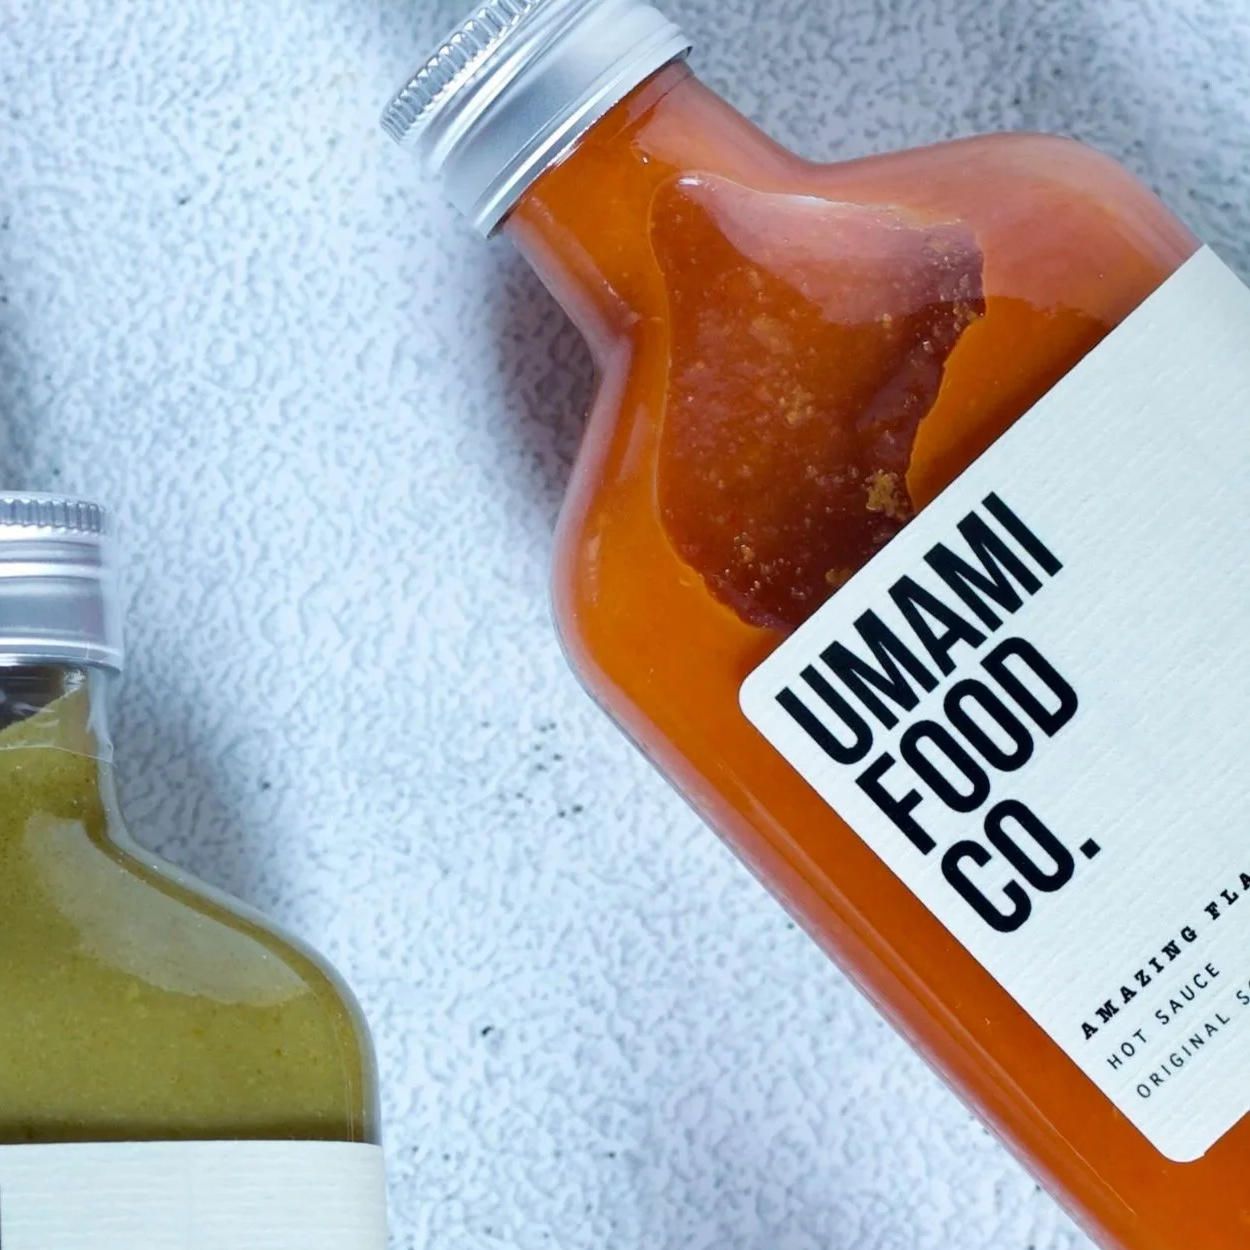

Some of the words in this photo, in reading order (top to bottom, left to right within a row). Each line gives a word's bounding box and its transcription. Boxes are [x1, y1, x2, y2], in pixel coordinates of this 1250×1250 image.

[775, 491, 1064, 765] UMAMI
[855, 636, 1079, 856] FOOD
[940, 799, 1101, 933] CO.
[1081, 925, 1198, 1041] AMAZING
[1106, 1028, 1148, 1070] HOT
[1154, 962, 1220, 1026] SAUCE
[1136, 1013, 1231, 1099] ORIGINAL
